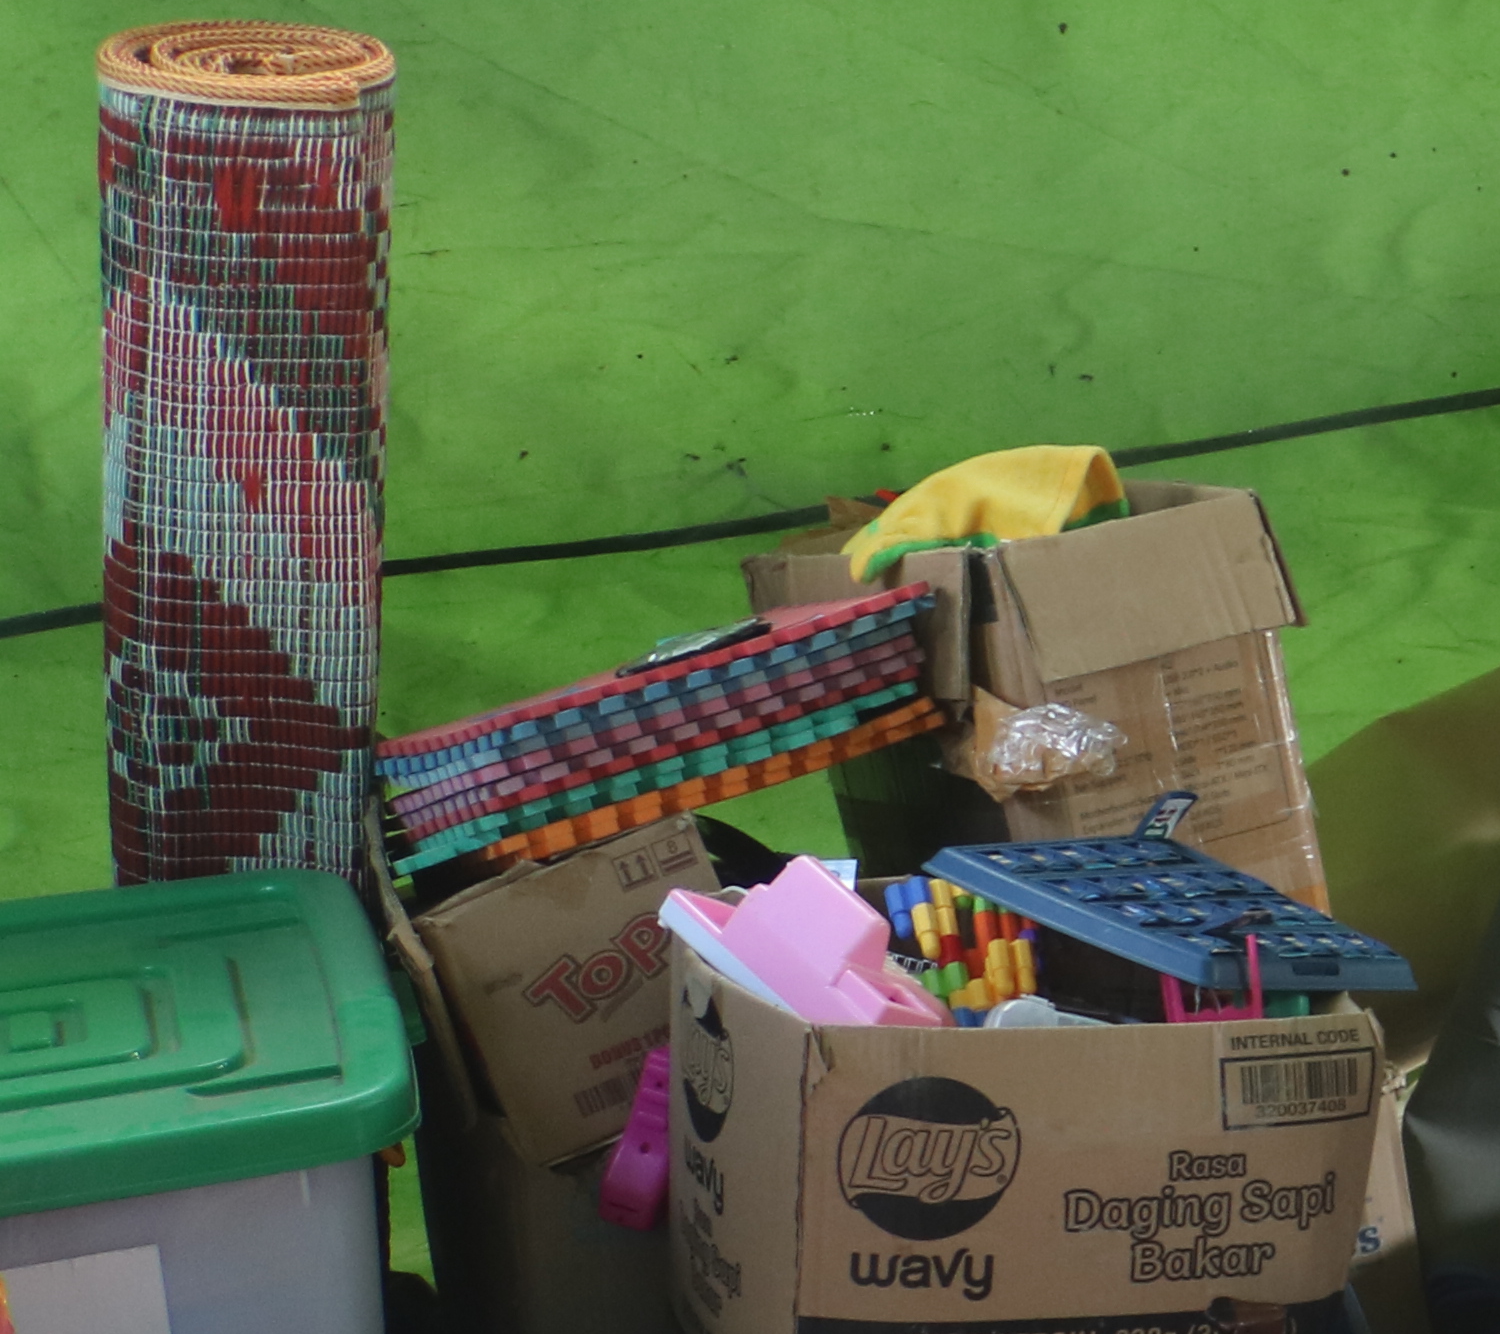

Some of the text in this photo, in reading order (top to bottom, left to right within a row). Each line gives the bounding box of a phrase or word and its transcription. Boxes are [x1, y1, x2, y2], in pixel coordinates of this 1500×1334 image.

[1230, 1028, 1359, 1051] INTERNAL CODE
[1255, 1099, 1347, 1119] 320037408
[848, 1115, 1010, 1204] Lay's
[1169, 1150, 1246, 1182] Rasa
[1064, 1172, 1337, 1239] Daging Sapi
[849, 1248, 994, 1302] wavy
[1130, 1236, 1275, 1284] Bakar
